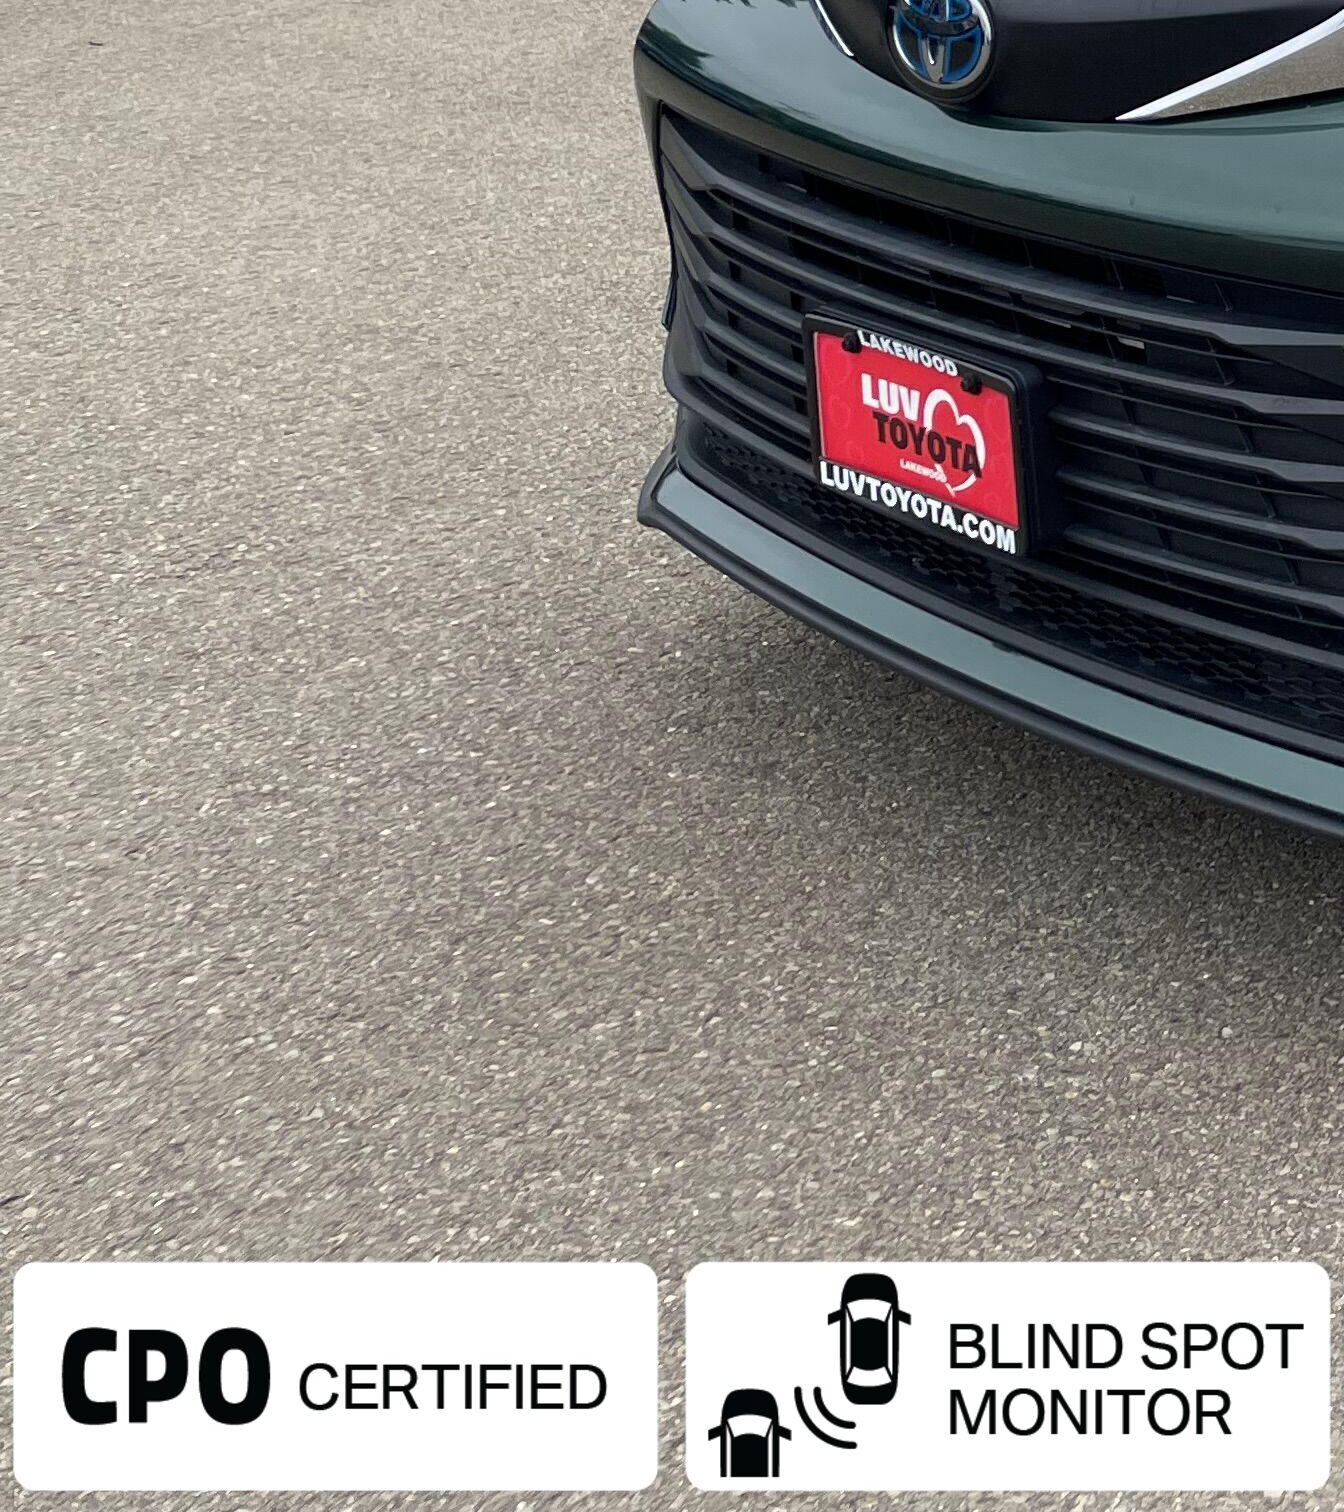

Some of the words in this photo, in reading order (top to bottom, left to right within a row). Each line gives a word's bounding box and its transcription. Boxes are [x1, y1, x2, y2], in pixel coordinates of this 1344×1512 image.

[857, 329, 958, 377] LAKEWOOD
[861, 373, 920, 422] LUV
[873, 412, 982, 478] TOYOTA
[819, 460, 1016, 555] LUVTOYOTA.COM
